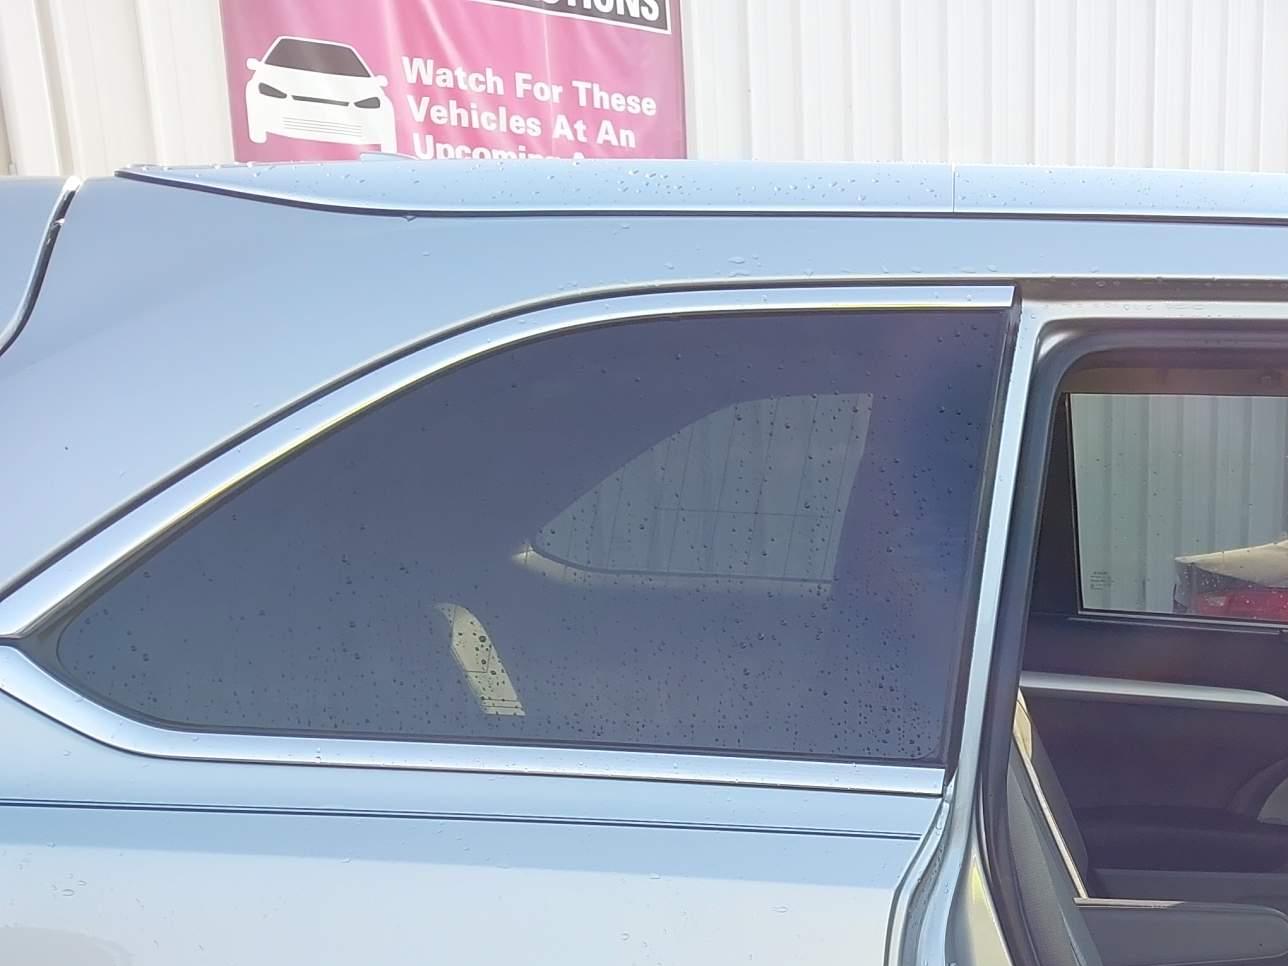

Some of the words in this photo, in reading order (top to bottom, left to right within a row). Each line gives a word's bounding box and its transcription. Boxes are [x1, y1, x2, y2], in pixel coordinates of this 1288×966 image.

[402, 56, 504, 95] Watch
[515, 72, 563, 104] For
[571, 80, 657, 116] These
[408, 97, 542, 137] Vehicles
[553, 115, 587, 143] At
[597, 120, 636, 148] An
[414, 133, 562, 160] Upcomi
